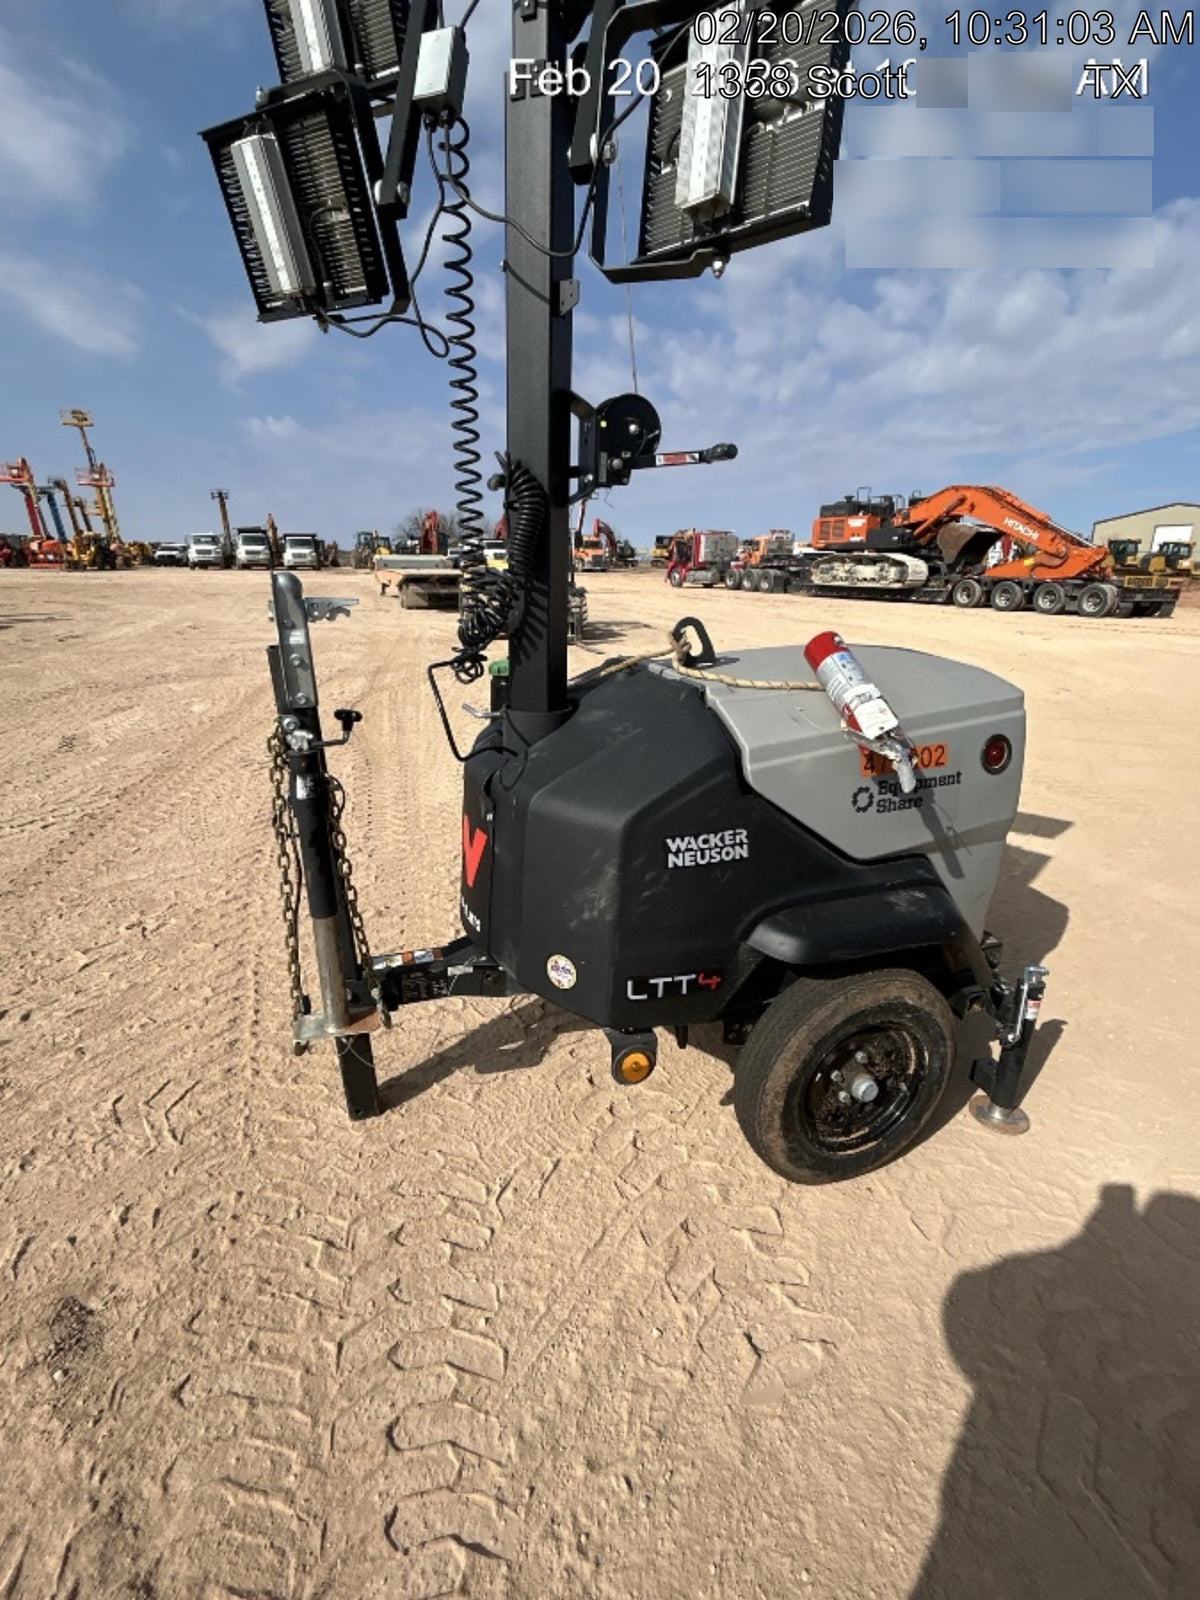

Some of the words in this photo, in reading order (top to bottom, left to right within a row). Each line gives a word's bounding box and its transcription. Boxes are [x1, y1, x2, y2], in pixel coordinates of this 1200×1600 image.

[1003, 516, 1040, 541] HITACHI
[876, 797, 923, 814] Share
[665, 828, 749, 853] WACKER
[667, 843, 749, 869] NEUSON
